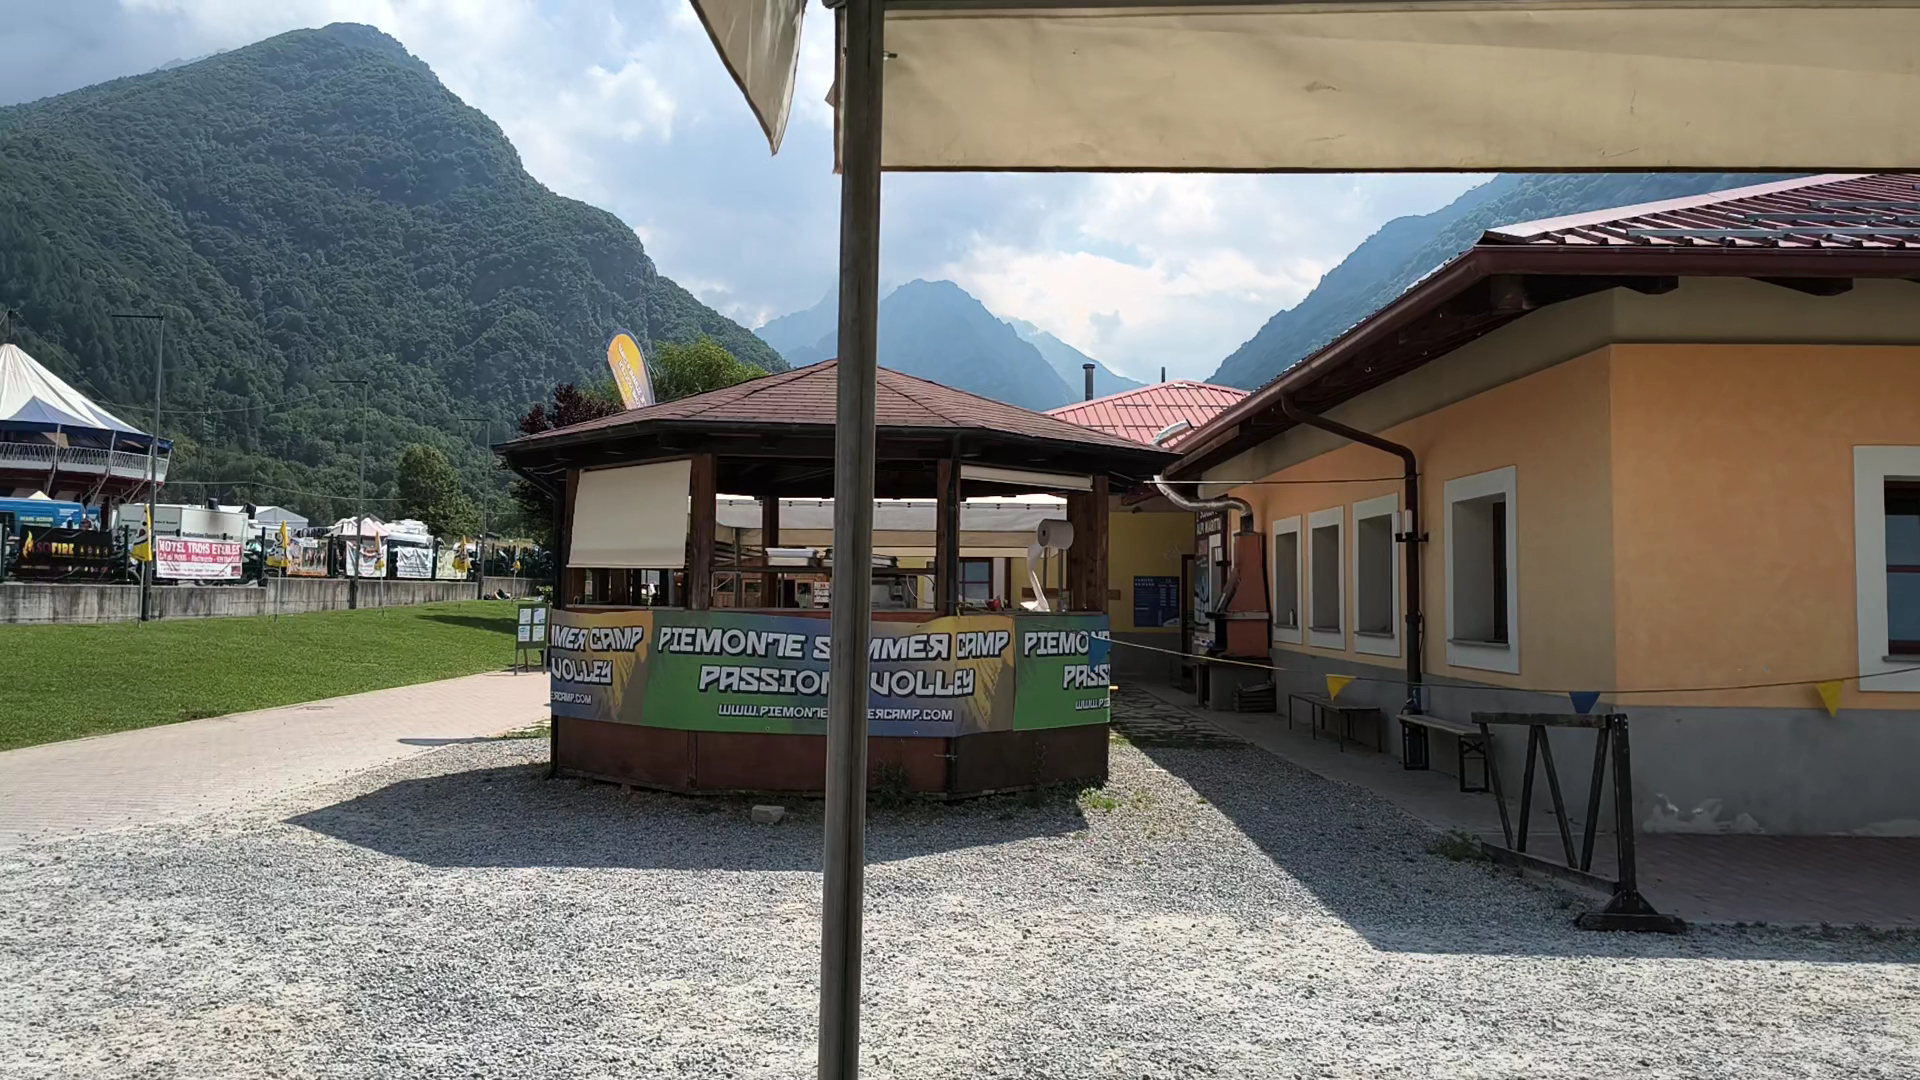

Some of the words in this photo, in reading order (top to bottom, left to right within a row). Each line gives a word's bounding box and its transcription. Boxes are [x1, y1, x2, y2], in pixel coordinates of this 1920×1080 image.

[158, 540, 186, 553] HOTEL
[187, 542, 211, 555] TROIS
[551, 625, 590, 652] MER
[590, 626, 644, 652] CAMP
[657, 626, 807, 659] PIEMONTE
[812, 633, 951, 661] SMER
[956, 631, 1010, 658] CAMP
[551, 657, 613, 686] VOLLEY
[869, 668, 976, 697] VOLLEY
[1062, 664, 1110, 689] PASS
[718, 703, 954, 721] WWW.PIEMONTEERCAMP.COM
